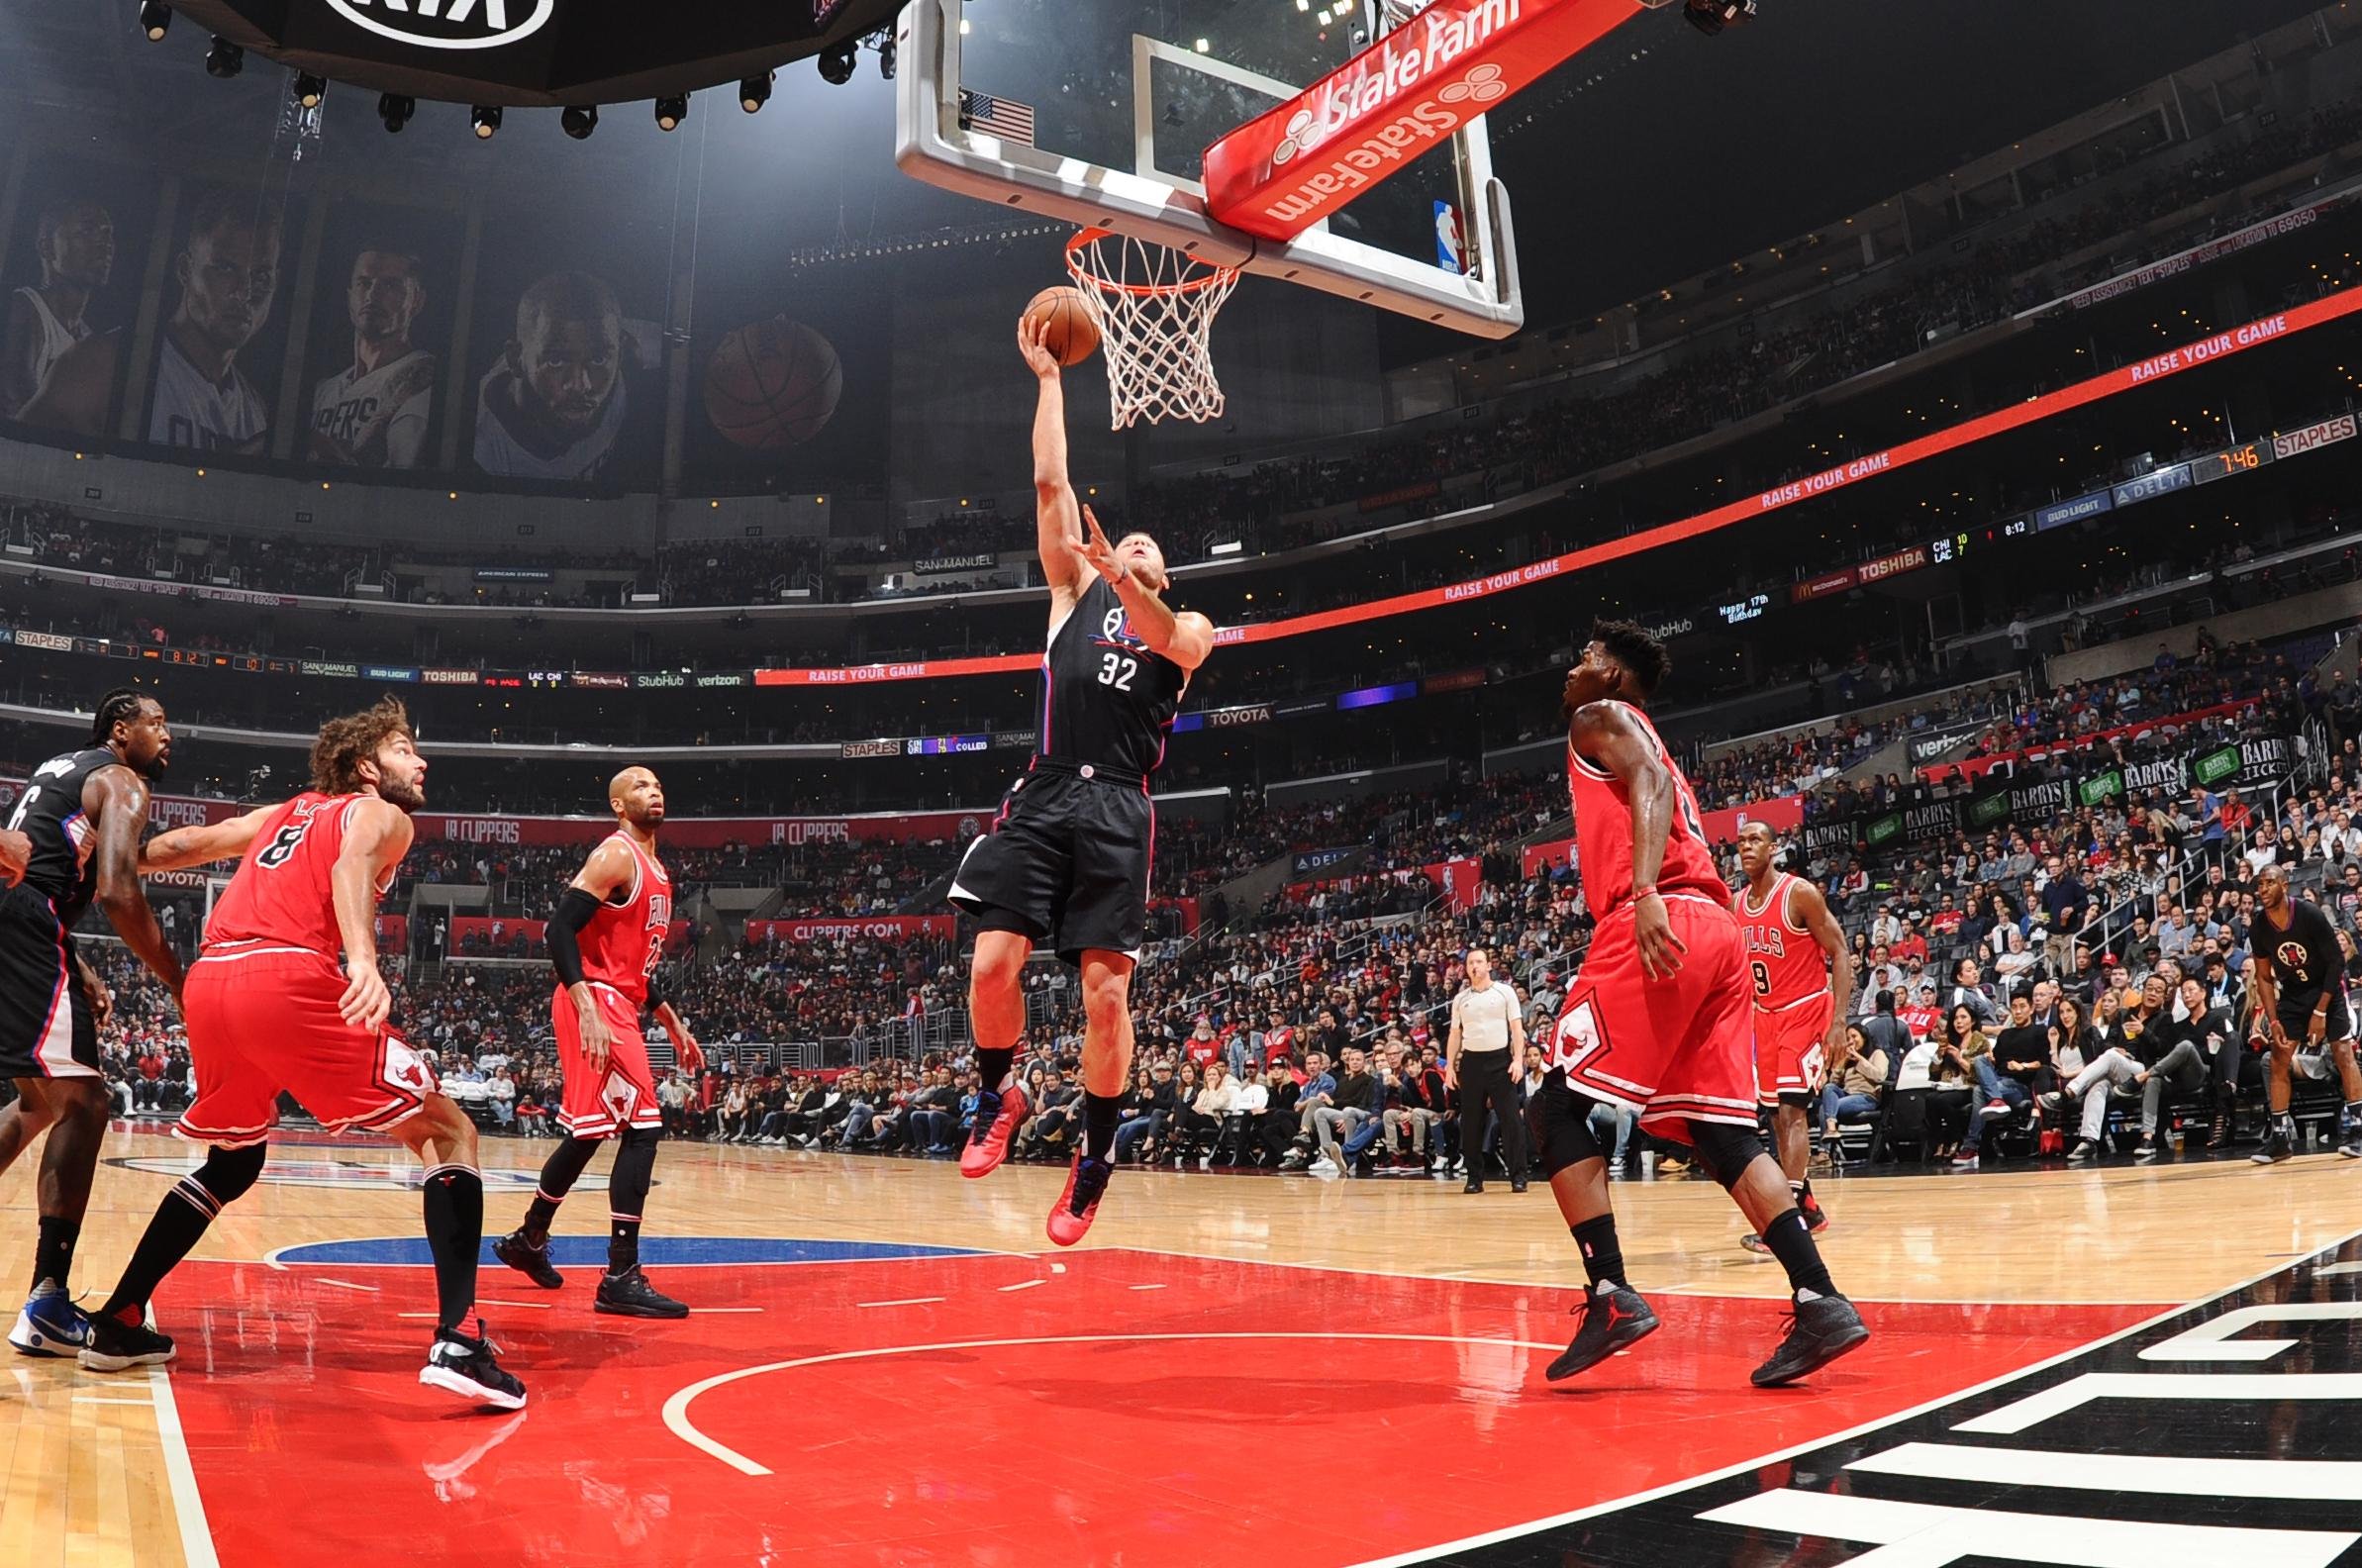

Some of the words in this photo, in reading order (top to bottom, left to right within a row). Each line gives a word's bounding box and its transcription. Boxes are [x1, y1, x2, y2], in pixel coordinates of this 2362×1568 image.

[2278, 209, 2316, 234] 69050
[2131, 353, 2179, 382] RAISE
[2183, 336, 2233, 362] YOUR
[2237, 316, 2287, 344] GAME
[2277, 418, 2354, 456] STAPLES
[2218, 446, 2259, 473] 7:46
[1761, 483, 1801, 508] RAISE
[1804, 467, 1844, 493] YOUR
[1848, 452, 1890, 478] GAME
[2133, 468, 2191, 498] DELTA
[2047, 509, 2069, 523] BUD
[2069, 500, 2100, 517] LIGHT
[2005, 521, 2025, 537] 8:12
[1932, 539, 1950, 553] CHI
[1957, 534, 1968, 545] 10
[915, 560, 939, 572] SAN
[944, 554, 994, 569] MANUEL
[1933, 549, 1953, 563] LAC
[1957, 545, 1964, 556] 7
[1859, 549, 1925, 580] TOSHIBA
[1445, 581, 1483, 600] RAISE
[1486, 571, 1521, 591] YOUR
[1524, 559, 1559, 580] GAME
[252, 594, 280, 605] 69050
[1719, 602, 1746, 617] Happy
[1750, 594, 1769, 608] 17th
[17, 632, 70, 650] STAPLES
[302, 661, 320, 671] SAN
[325, 663, 356, 673] MANUEL
[387, 670, 411, 679] LIGHT
[809, 670, 845, 682] RAISE
[849, 668, 885, 680] YOUR
[889, 664, 926, 678] GAME
[1098, 653, 1137, 692] 32
[423, 671, 478, 682] TOSHIBA
[529, 672, 544, 681] LAC
[547, 672, 562, 681] CHI
[638, 676, 685, 687] StubHub
[697, 676, 740, 687] verizon
[1210, 708, 1270, 726] TOYOTA
[844, 741, 899, 757] STAPLES
[148, 800, 206, 826] CLIPPERS
[460, 820, 520, 843] CLIPPERS
[789, 823, 848, 845] CLIPPERS
[1908, 822, 1954, 840] TICKETS
[255, 817, 314, 869] 8
[148, 870, 206, 886] TOYOTA
[1750, 960, 1772, 997] 9
[2297, 969, 2309, 982] 3
